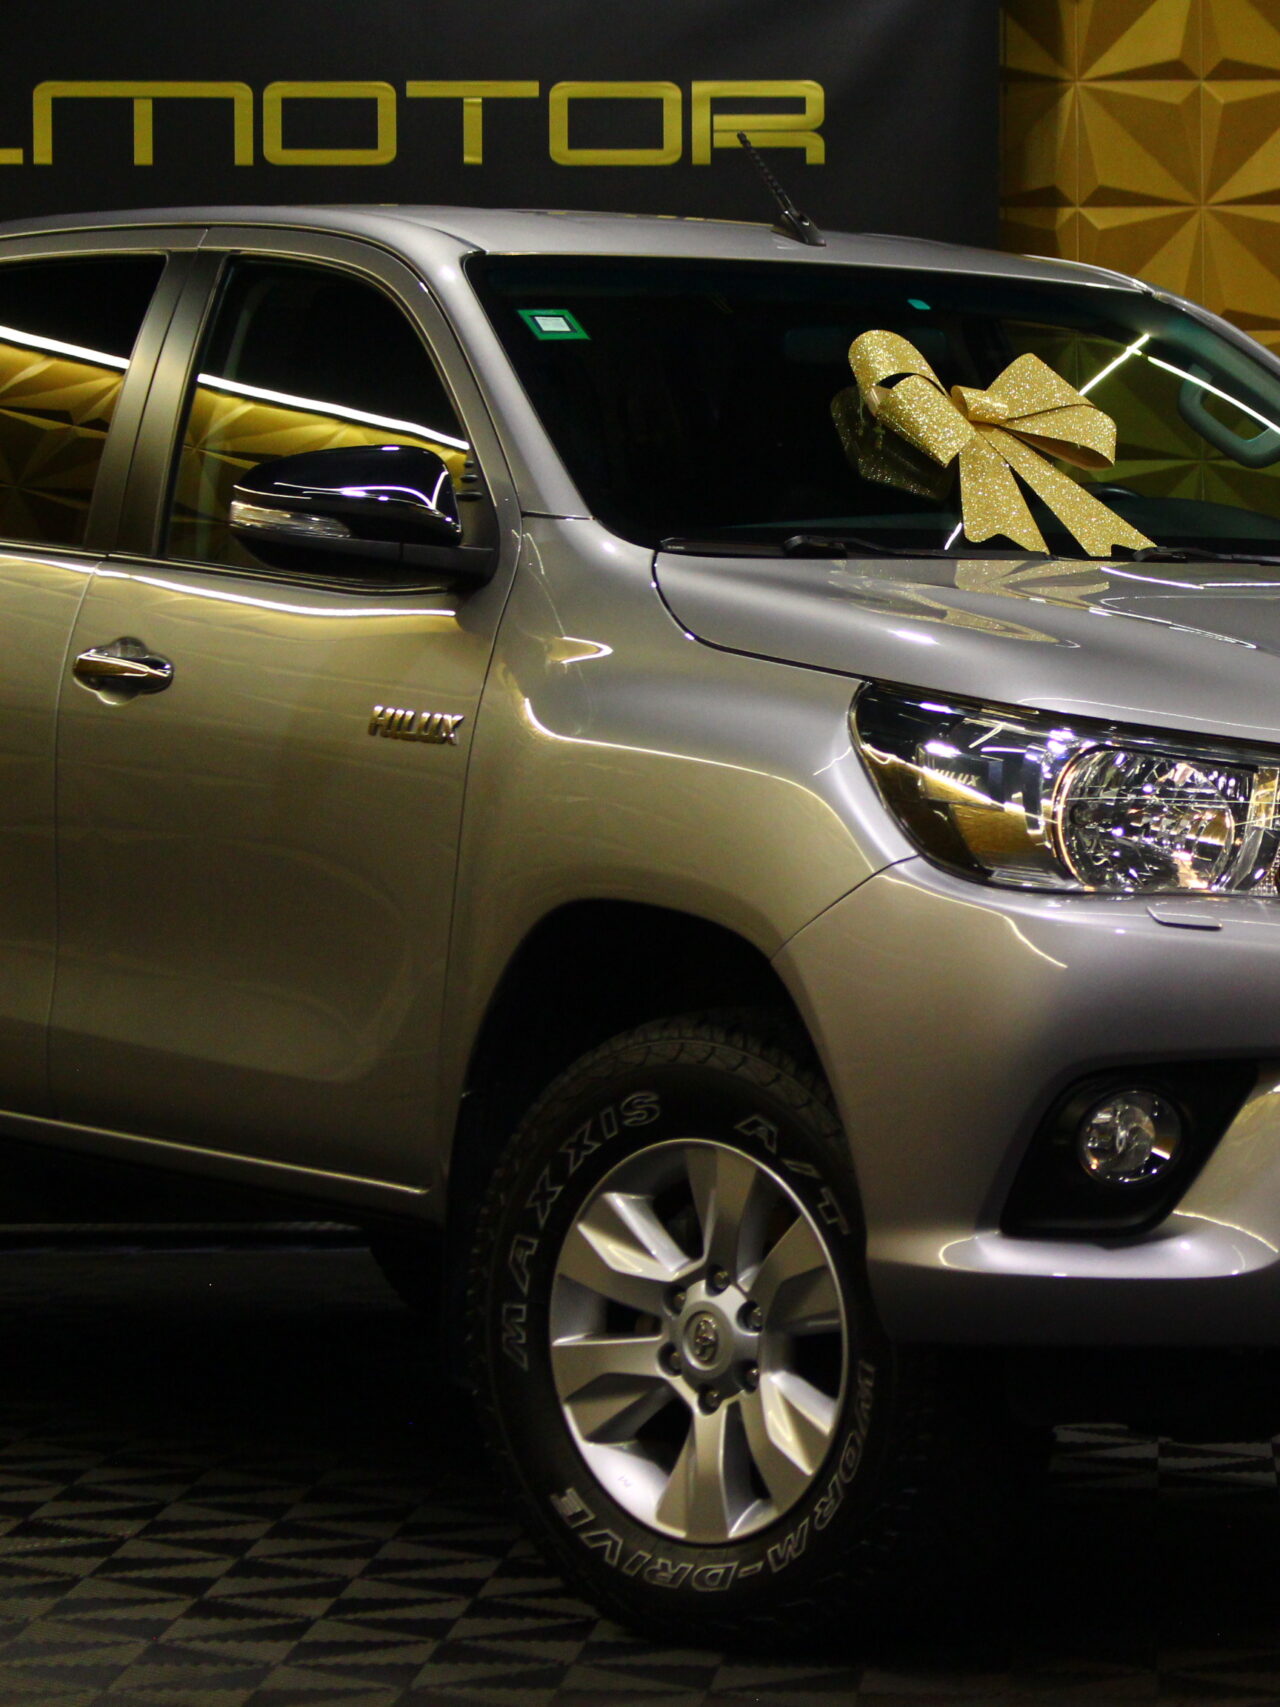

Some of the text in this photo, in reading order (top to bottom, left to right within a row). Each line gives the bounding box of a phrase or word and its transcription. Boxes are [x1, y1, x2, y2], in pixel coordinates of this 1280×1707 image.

[0, 80, 825, 166] MOTOR
[367, 705, 465, 746] HILUX
[502, 1090, 662, 1371] MAXXIS
